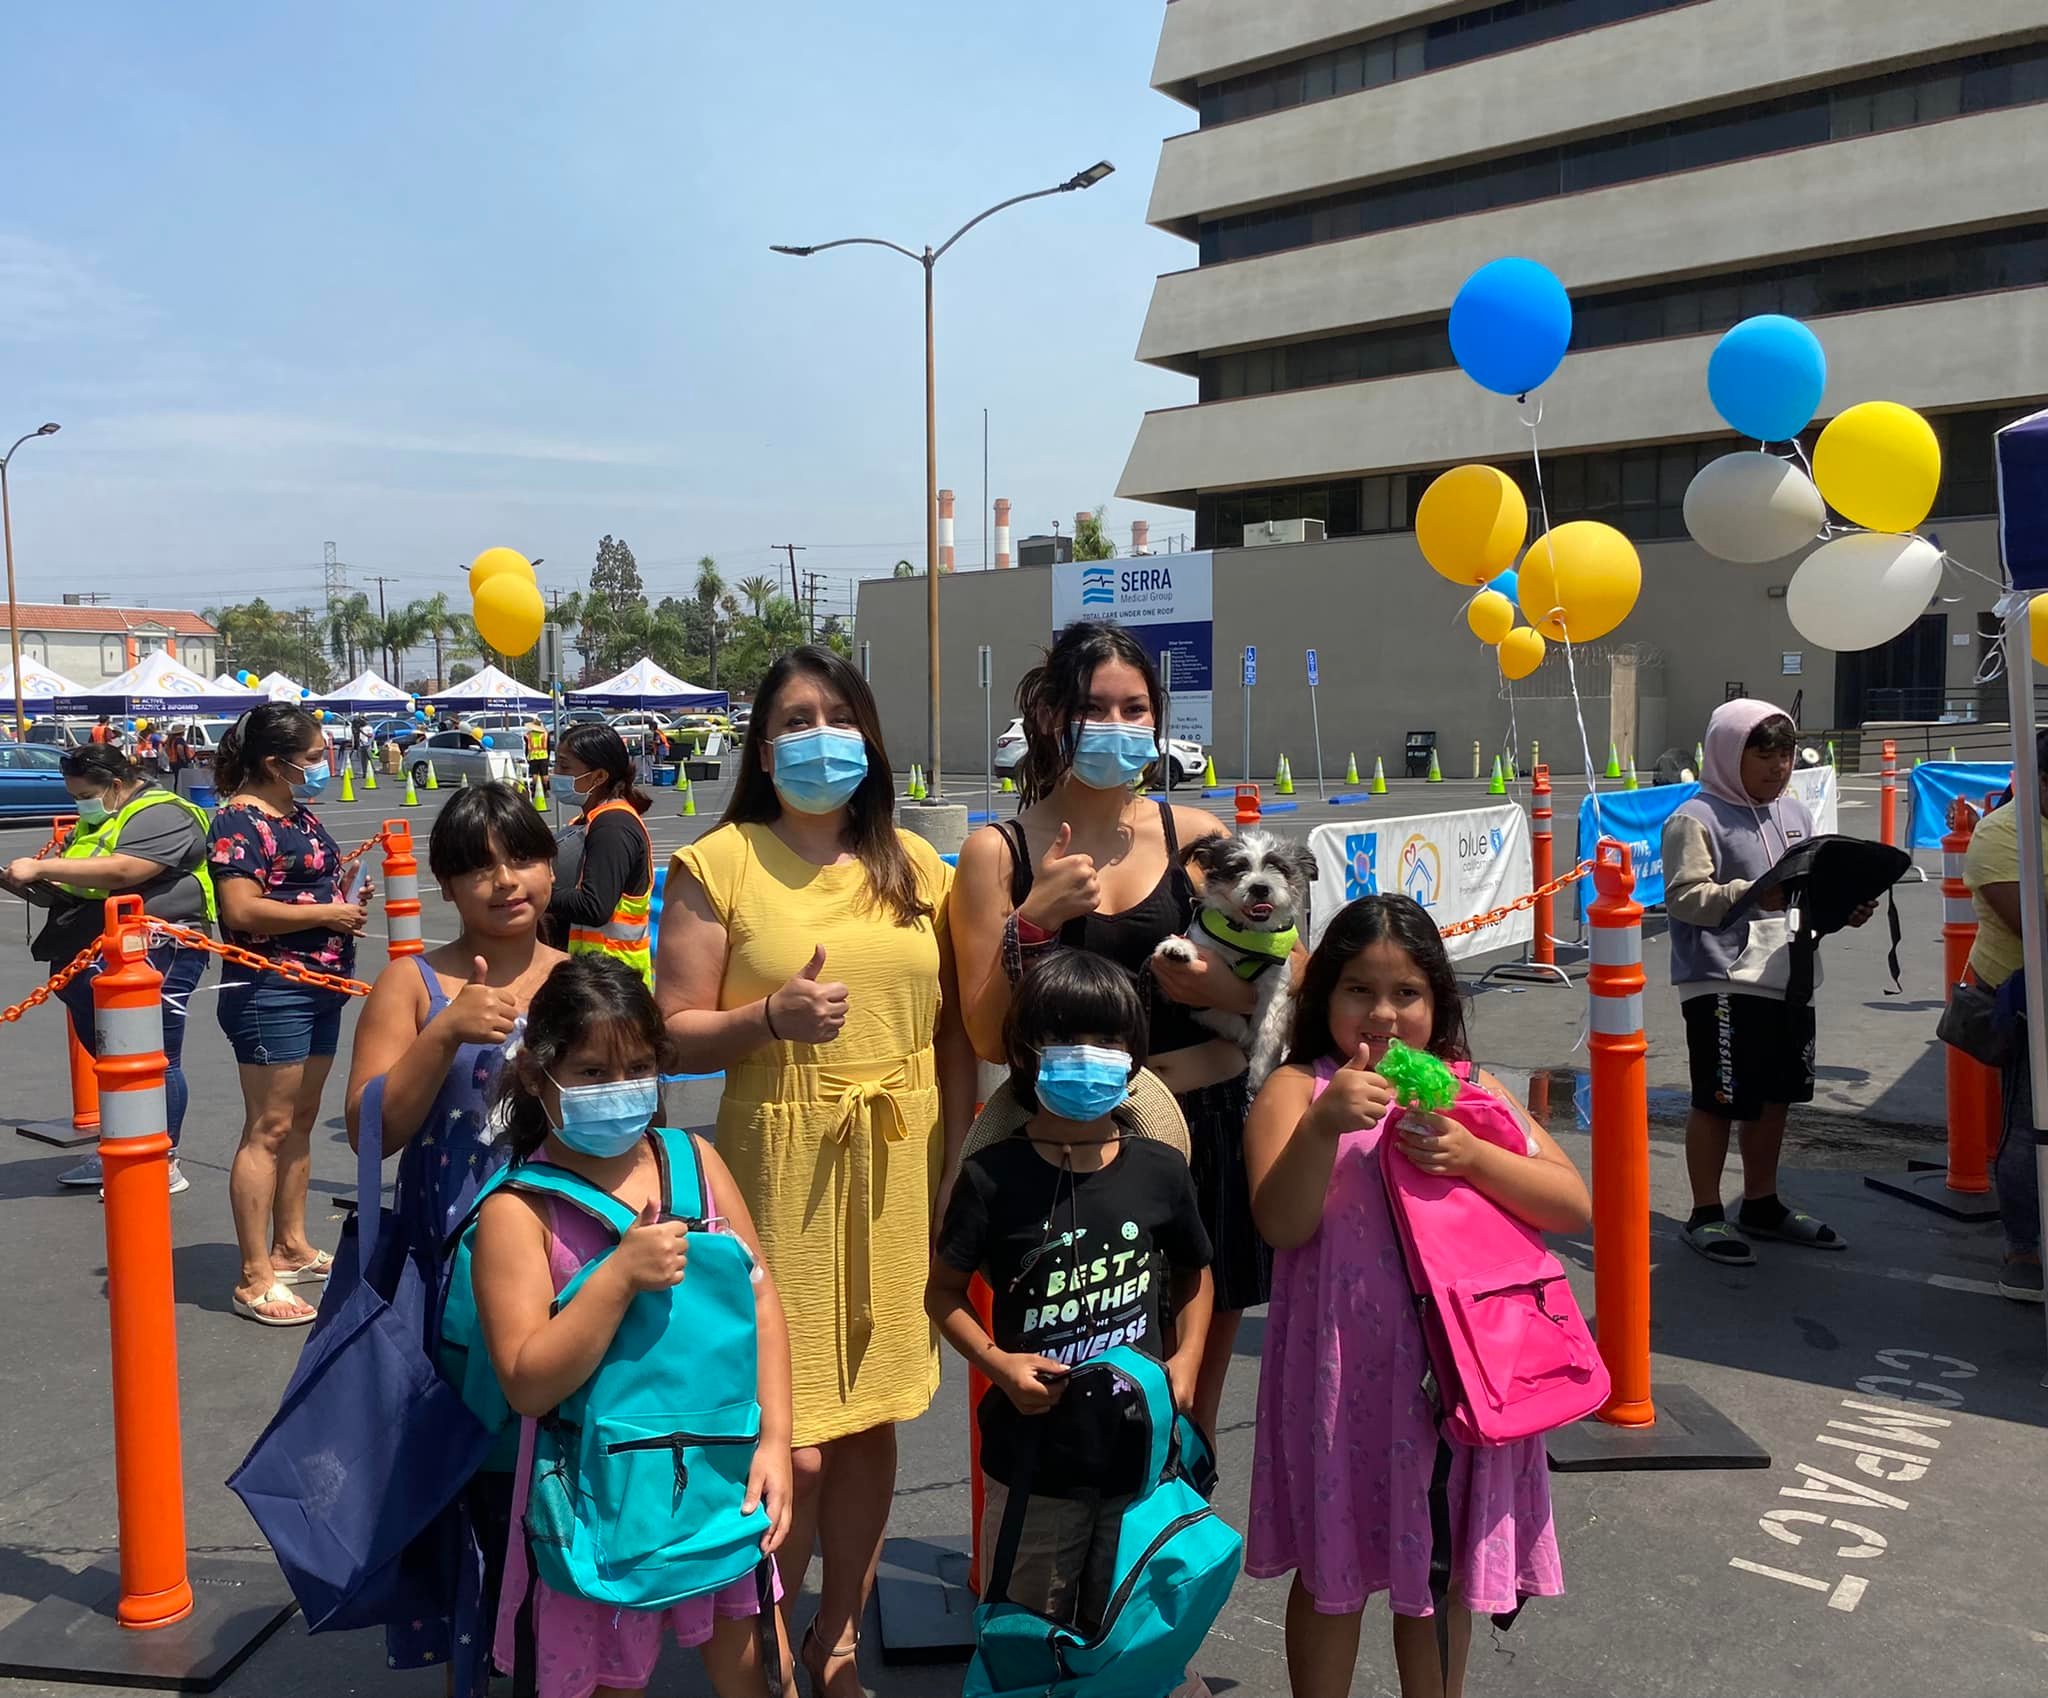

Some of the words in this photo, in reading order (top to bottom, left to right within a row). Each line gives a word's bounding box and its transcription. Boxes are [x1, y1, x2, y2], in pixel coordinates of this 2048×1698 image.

[1121, 568, 1172, 592] SERRA
[1120, 593, 1148, 604] Medical
[1150, 591, 1173, 602] Group
[1083, 612, 1100, 621] TOTAL
[1102, 611, 1118, 619] CARE
[1119, 609, 1141, 618] UNDER
[1142, 607, 1155, 616] ONE
[1157, 606, 1175, 616] ROOF
[1459, 831, 1488, 858] blue
[1047, 1250, 1136, 1297] BEST
[1024, 1270, 1151, 1333] BROTHER
[1729, 1349, 1979, 1612] COMPACT
